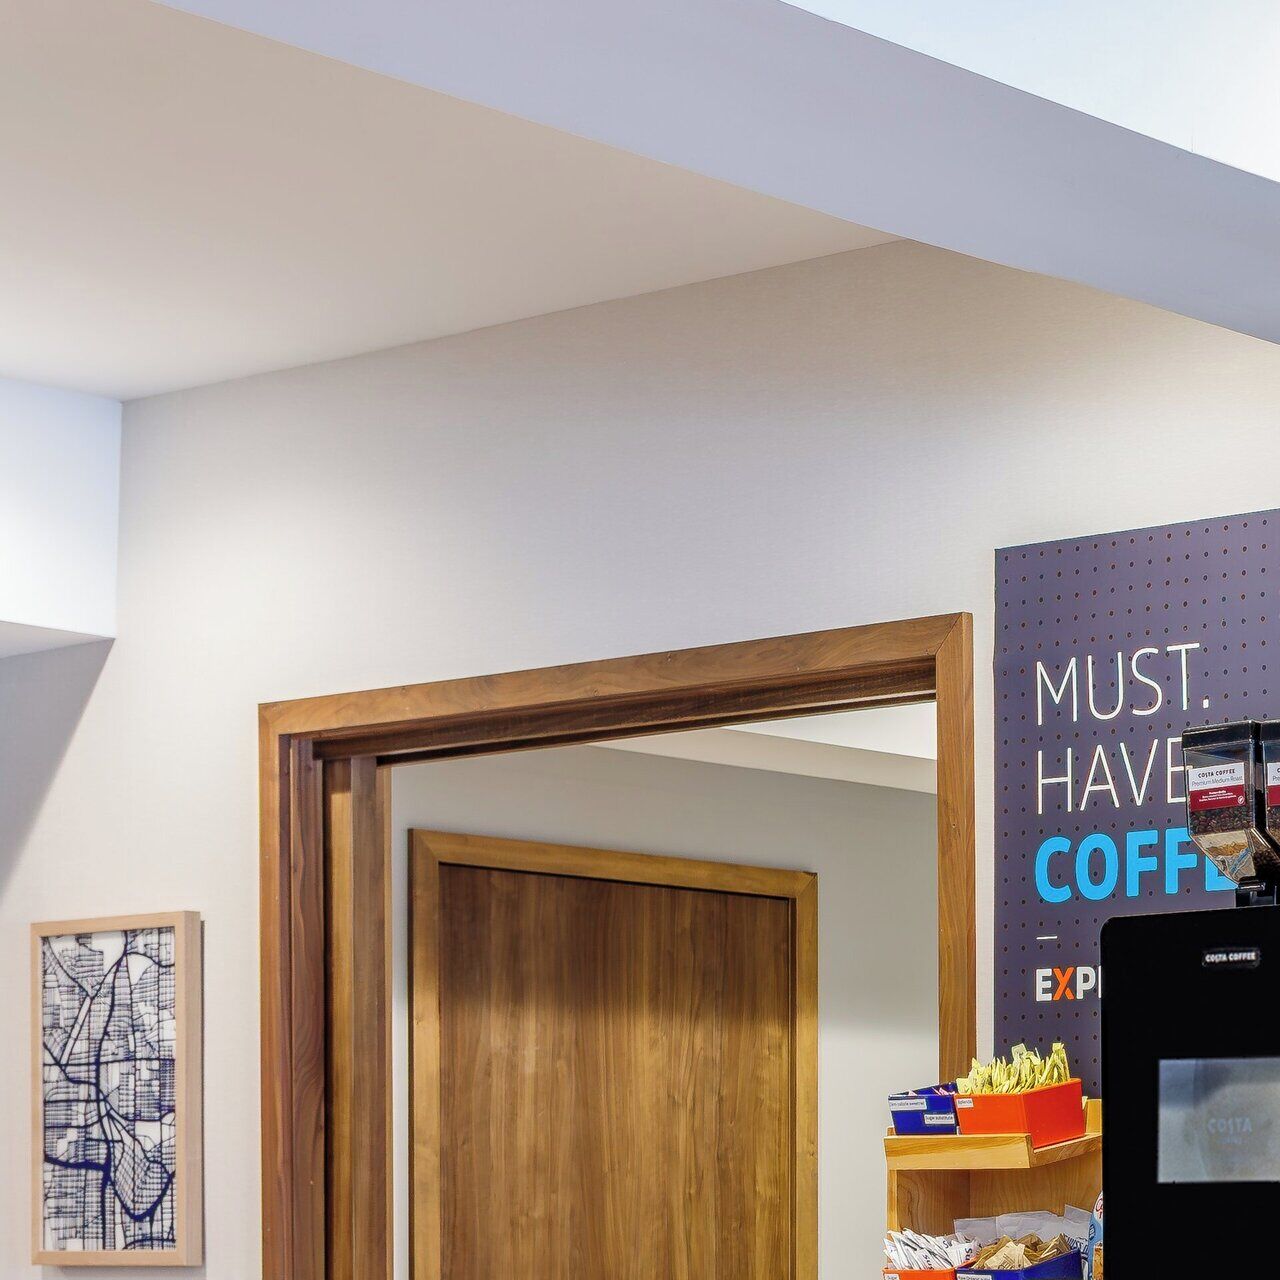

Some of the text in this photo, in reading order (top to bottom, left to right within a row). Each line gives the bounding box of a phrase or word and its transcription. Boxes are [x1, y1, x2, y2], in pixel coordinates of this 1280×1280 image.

[1036, 643, 1209, 726] MUST.
[1198, 768, 1236, 779] COSTA COFFEE
[1205, 951, 1257, 964] COSTA COFFEE
[1036, 965, 1102, 1002] EXP
[1207, 1117, 1253, 1134] COSTA
